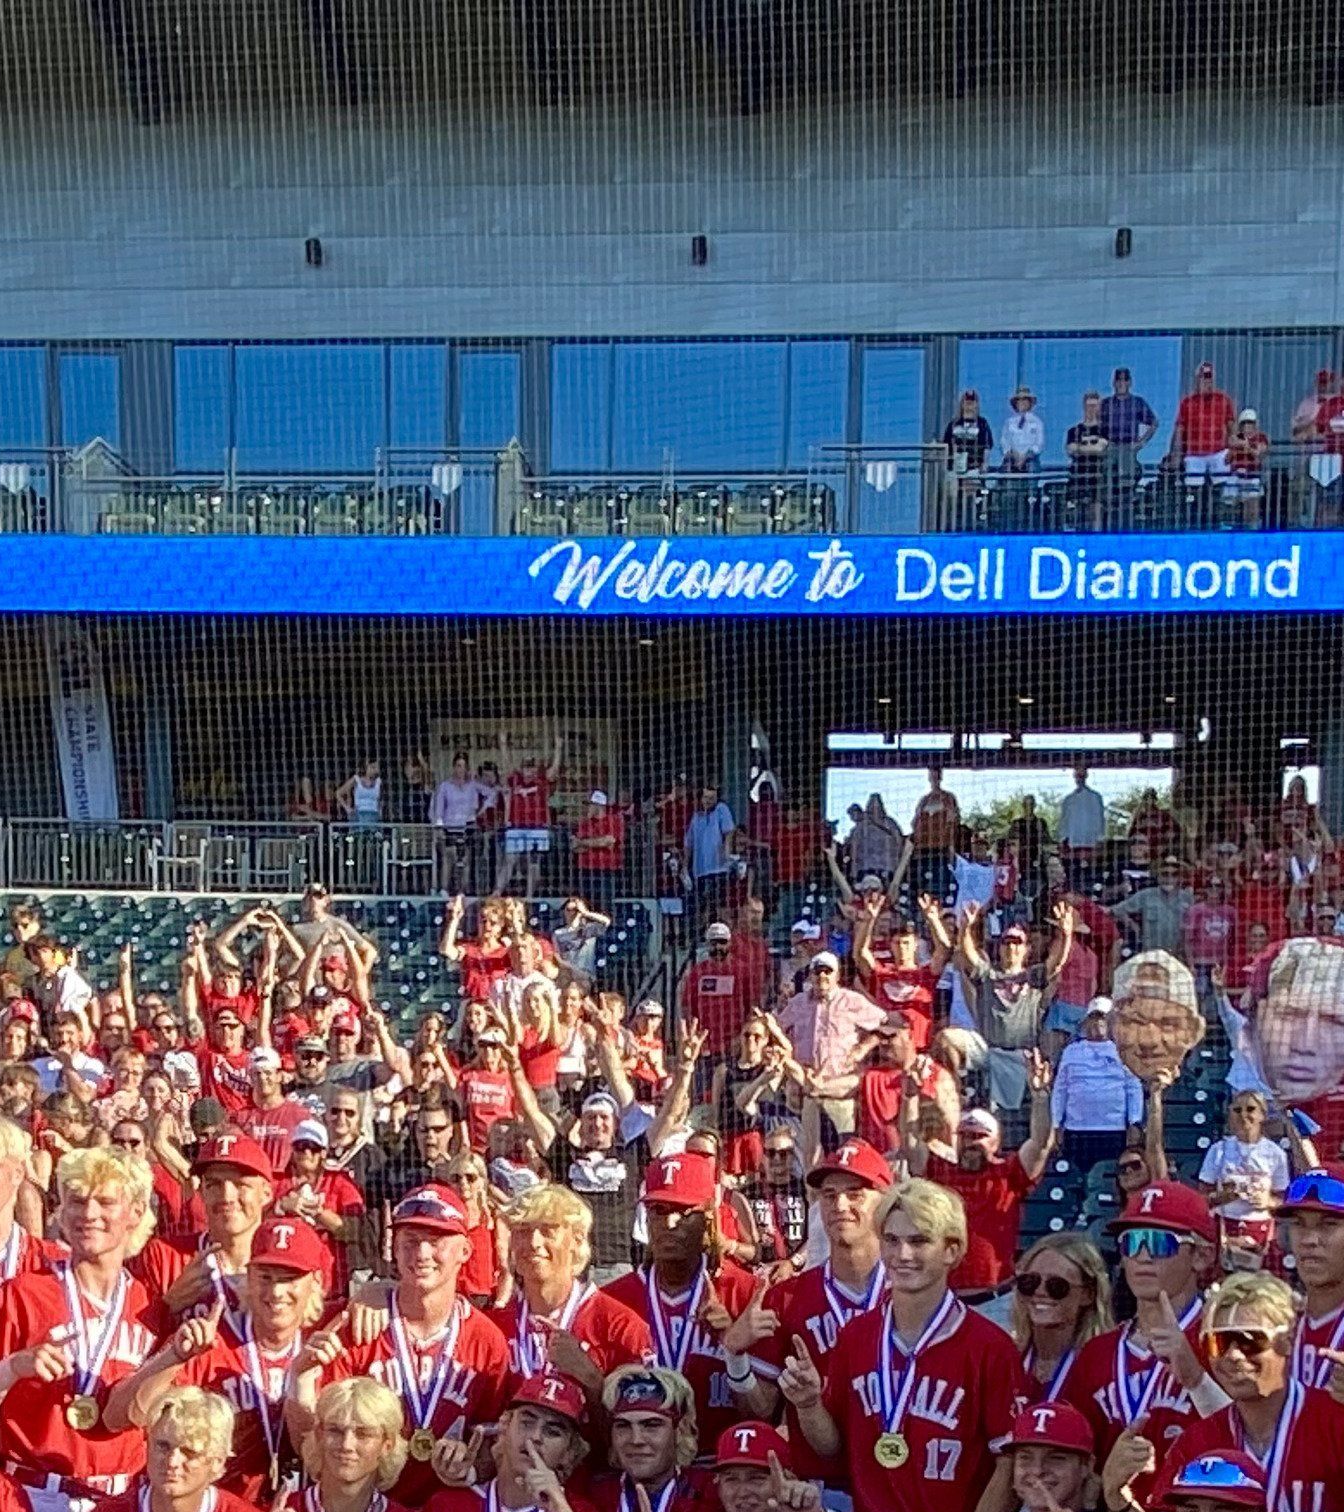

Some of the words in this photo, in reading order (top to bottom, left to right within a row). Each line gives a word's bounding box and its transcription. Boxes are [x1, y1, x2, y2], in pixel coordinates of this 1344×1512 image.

[528, 538, 800, 611] Welcome
[805, 538, 865, 602] to
[895, 547, 1006, 602] Dell
[1028, 544, 1301, 601] Diamond
[660, 1160, 682, 1186] T
[1141, 1187, 1164, 1213] T
[272, 1224, 296, 1249] T
[1032, 1407, 1056, 1433] T
[733, 1427, 757, 1453] T
[923, 1437, 964, 1482] 17
